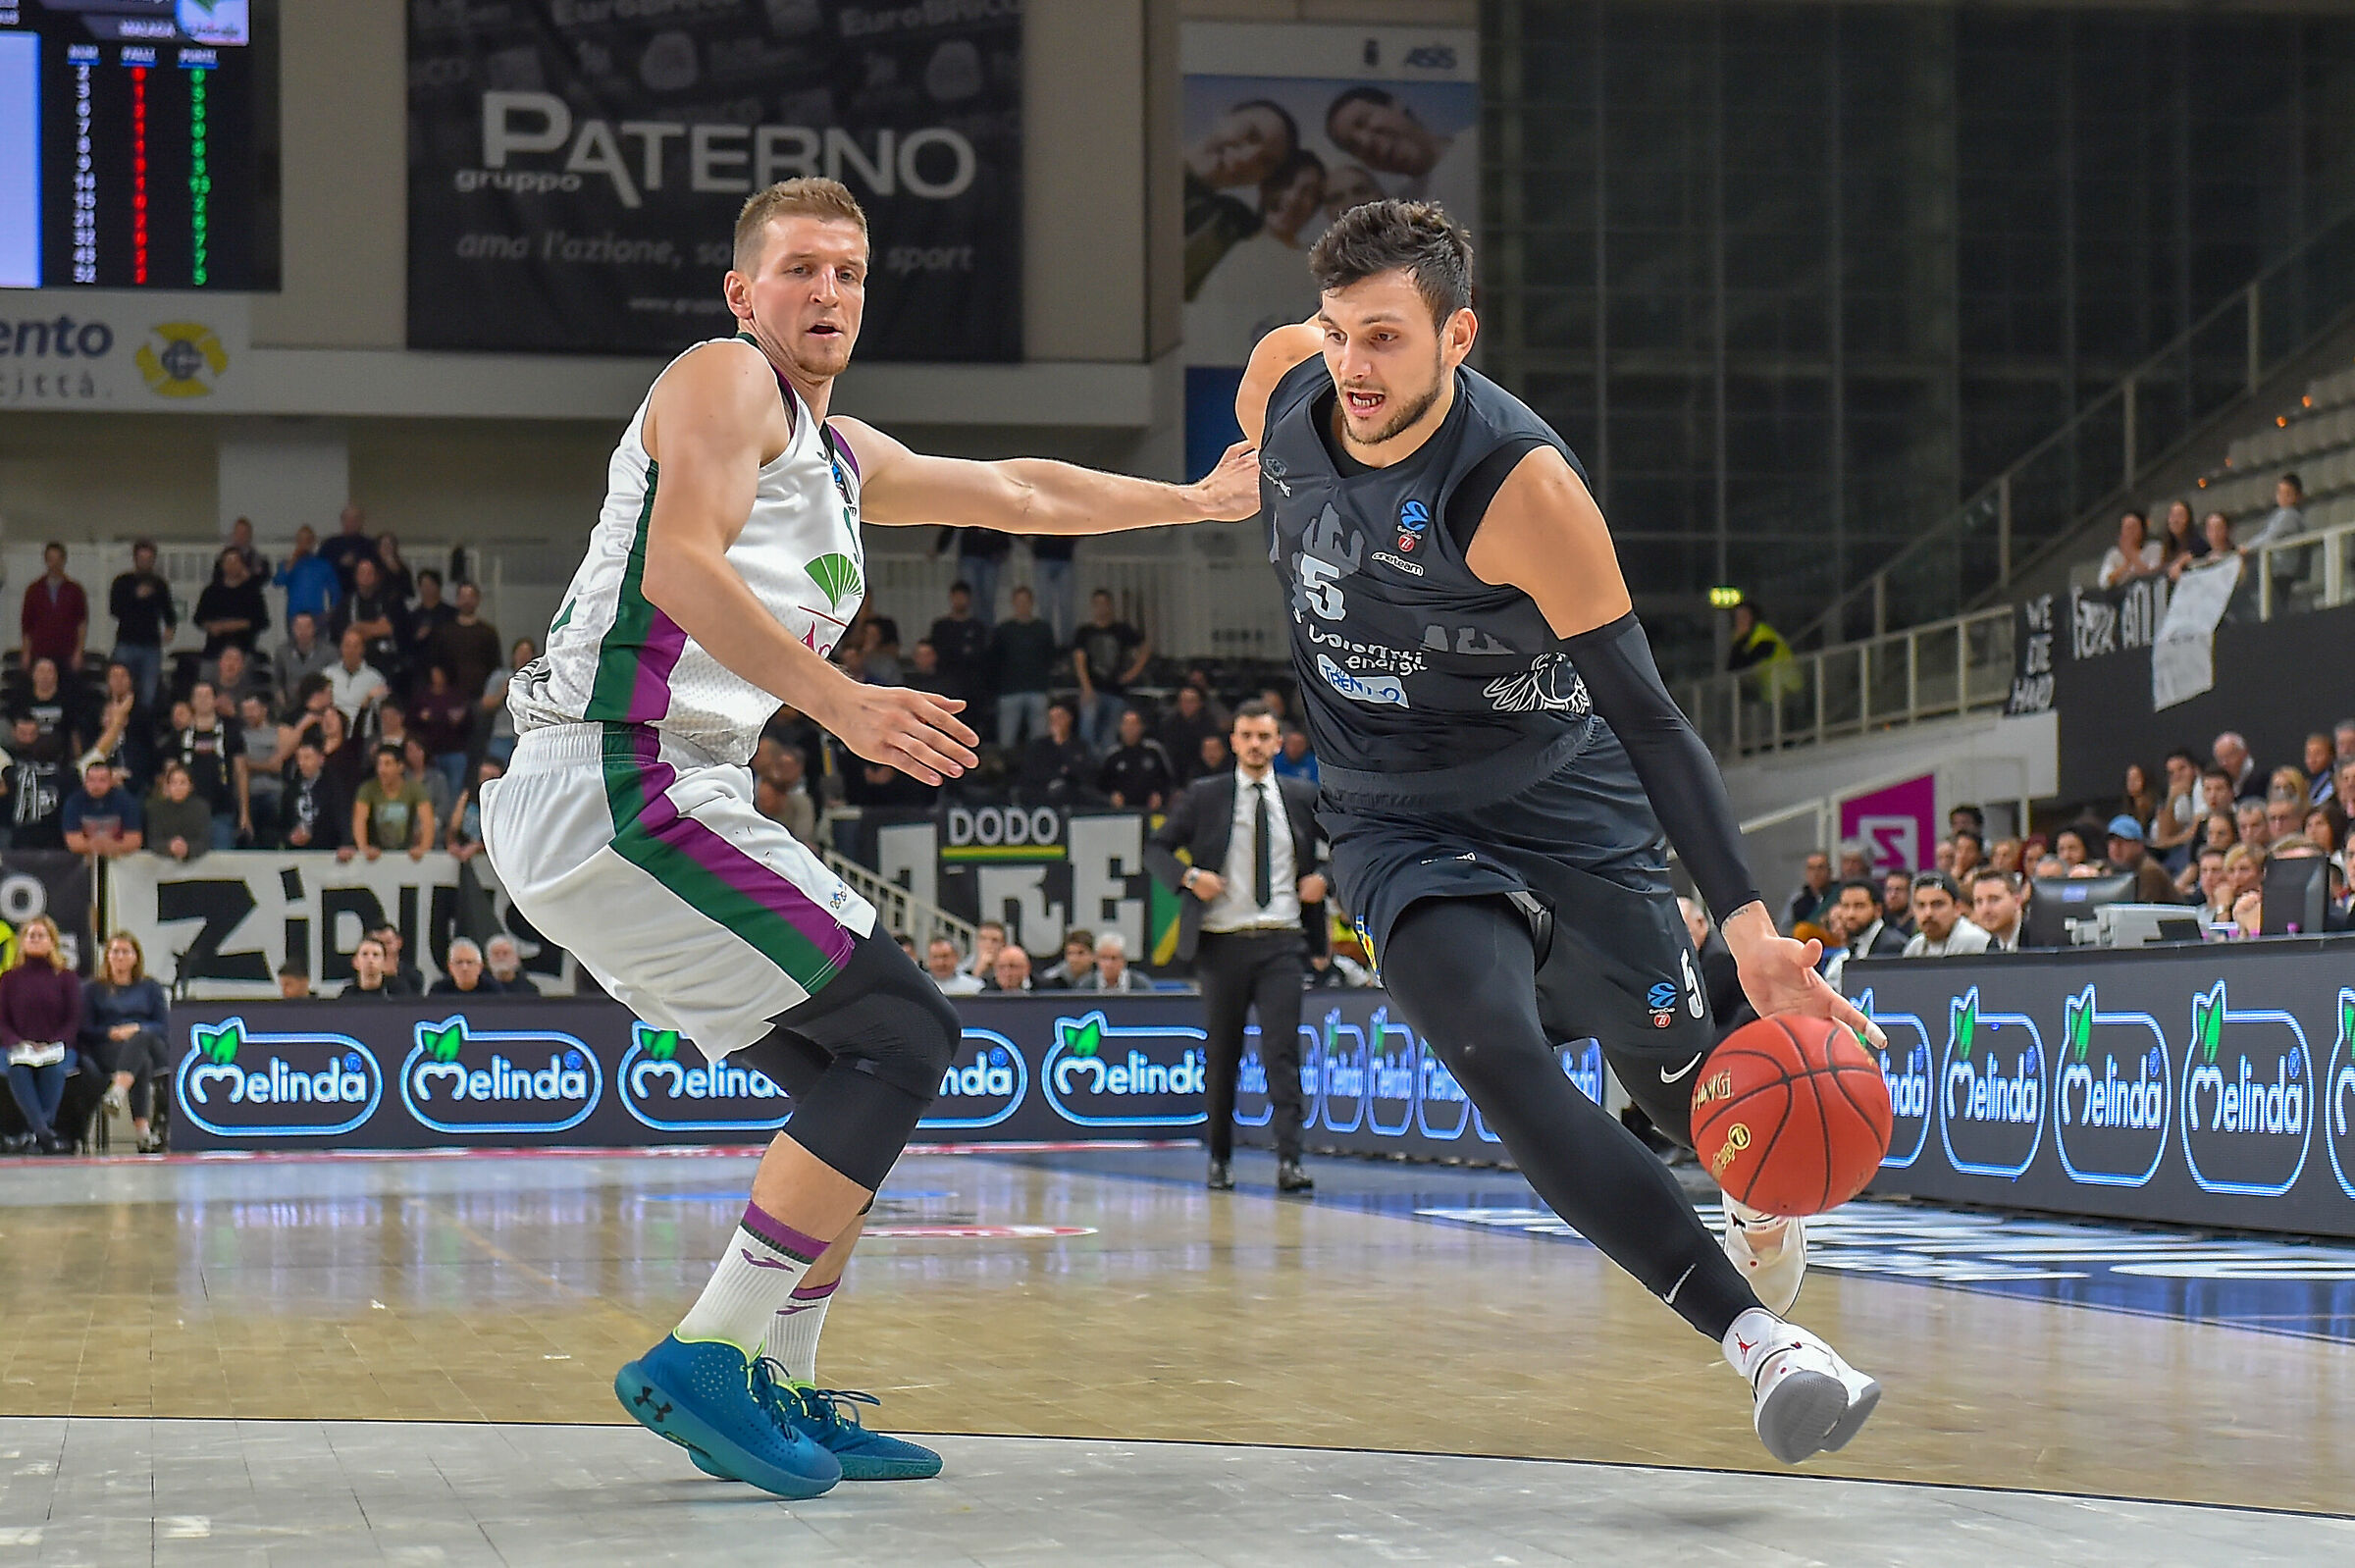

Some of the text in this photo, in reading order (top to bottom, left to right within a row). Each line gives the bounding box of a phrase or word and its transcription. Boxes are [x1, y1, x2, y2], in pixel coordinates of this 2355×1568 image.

[77, 119, 90, 136] 7
[482, 91, 976, 209] PATERNO
[454, 169, 583, 195] gruppo
[1300, 552, 1347, 621] 5
[948, 807, 1061, 846] DODO
[1680, 947, 1704, 1019] 5
[192, 1056, 367, 1105] Melinda
[413, 1055, 588, 1103] Melinda
[1947, 1051, 2038, 1124] Melinda
[2063, 1053, 2162, 1130] Melinda
[2189, 1053, 2304, 1135] Melinda
